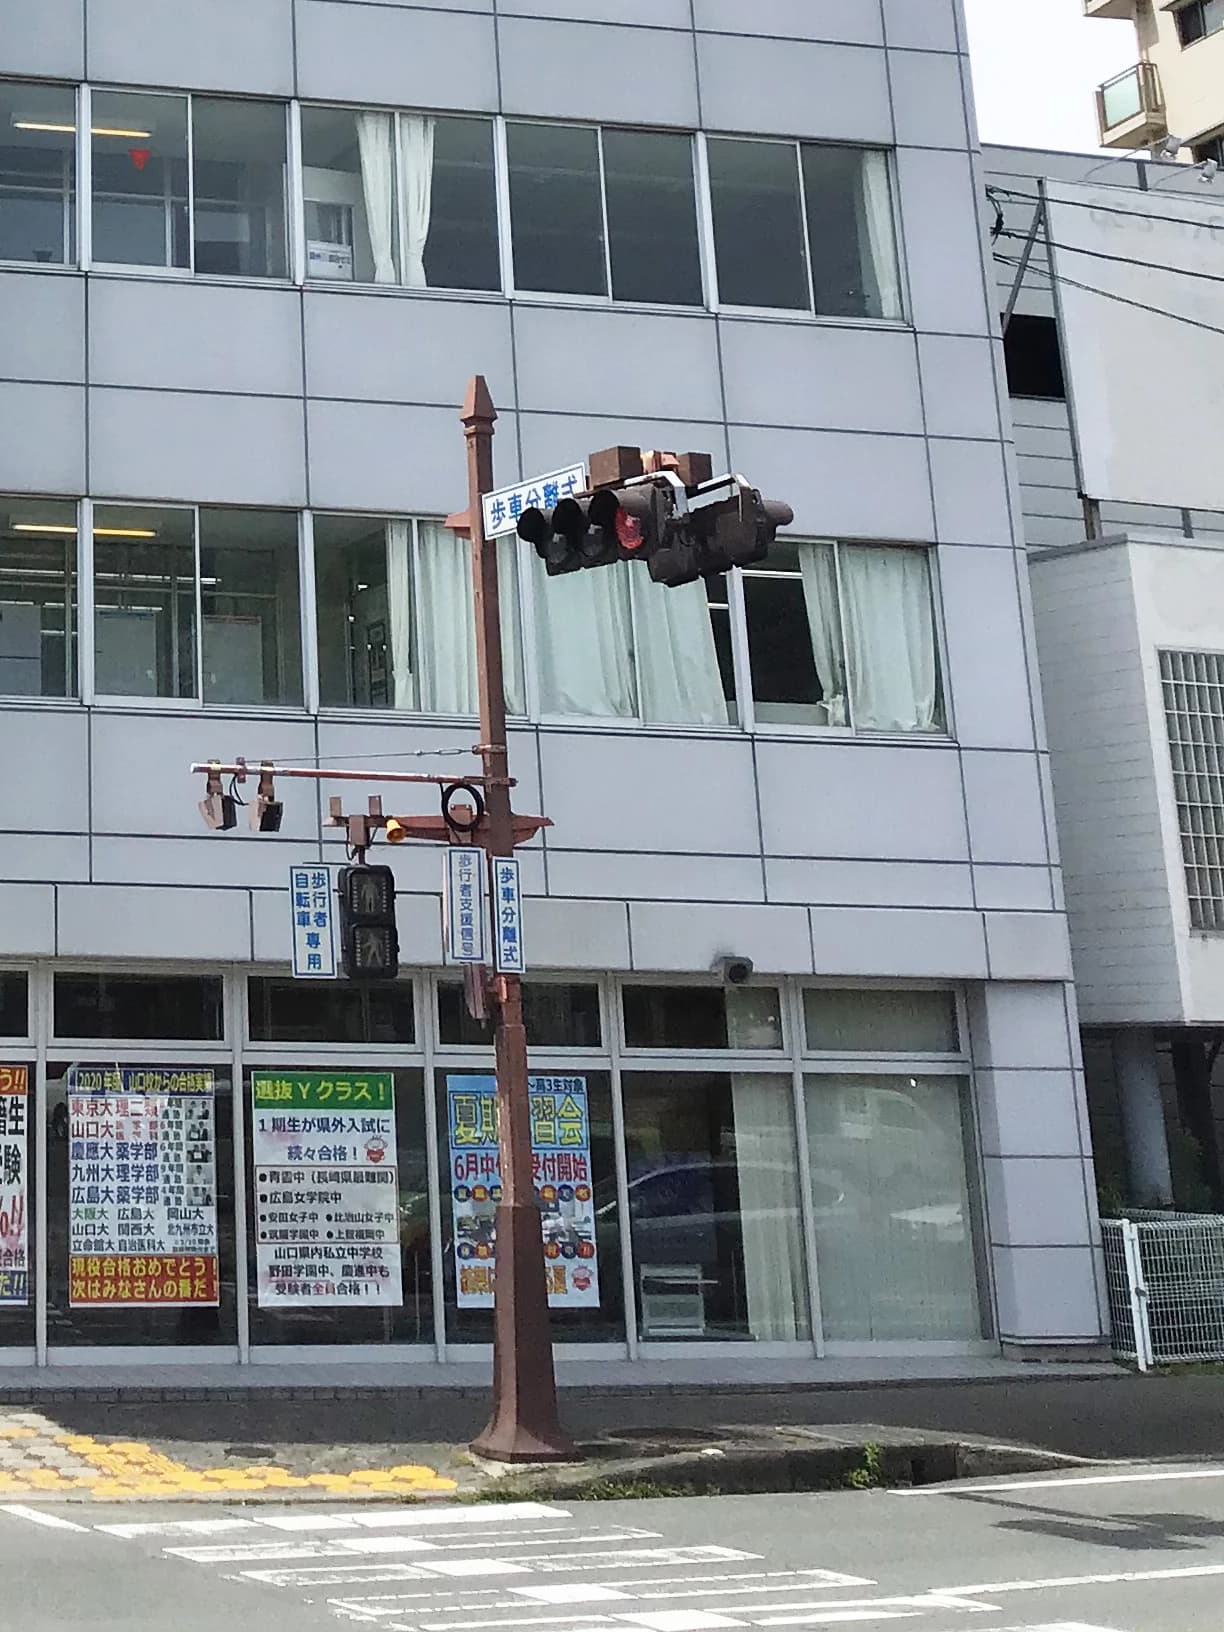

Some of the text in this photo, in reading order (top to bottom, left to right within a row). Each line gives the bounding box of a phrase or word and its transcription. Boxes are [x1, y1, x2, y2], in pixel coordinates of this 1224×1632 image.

[490, 474, 578, 530] 歩車分離式
[295, 872, 311, 928] 自転車
[312, 872, 328, 929] 歩行者
[458, 854, 475, 957] 歩行者支援信号
[499, 867, 519, 964] 歩車分離式
[305, 931, 322, 971] 専用
[71, 1121, 115, 1139] 山口大
[452, 1093, 584, 1146] 夏期習会
[71, 1163, 160, 1183] 九州大理学部
[72, 1223, 110, 1236] 山口大
[118, 1207, 155, 1221] 広島大
[167, 1207, 205, 1221] 岡山大
